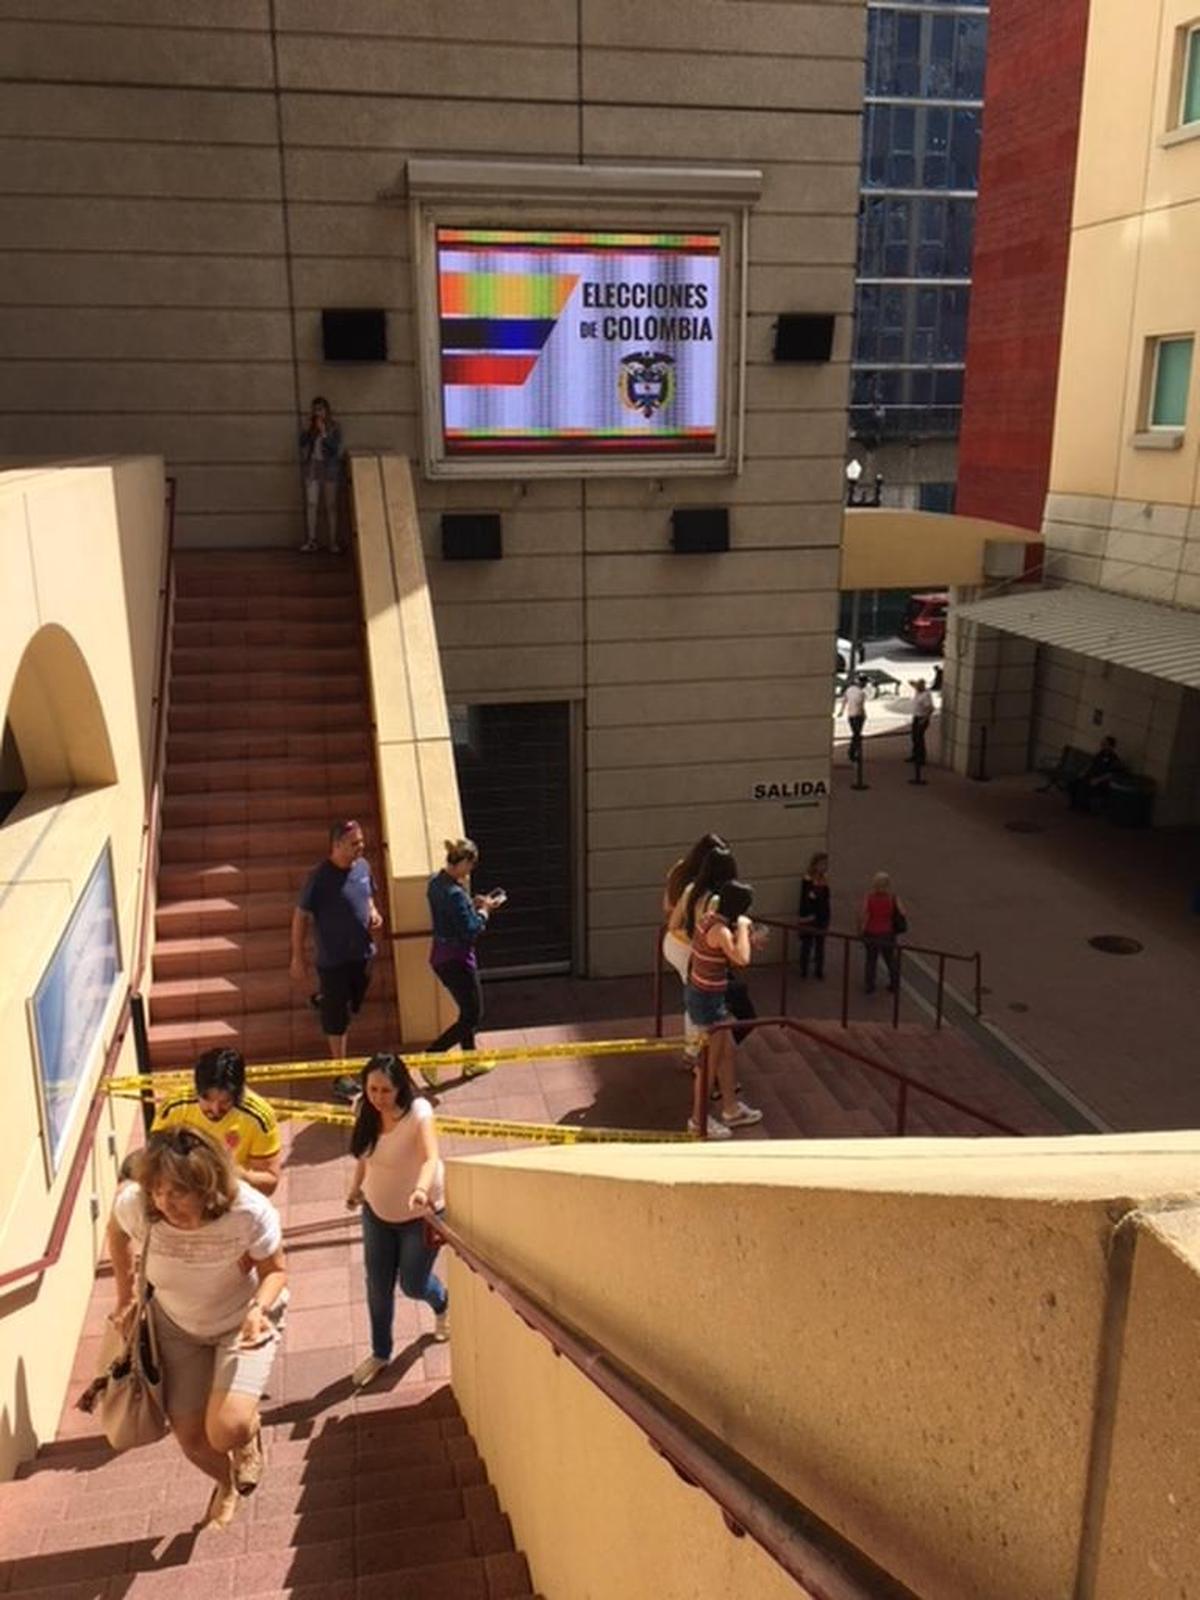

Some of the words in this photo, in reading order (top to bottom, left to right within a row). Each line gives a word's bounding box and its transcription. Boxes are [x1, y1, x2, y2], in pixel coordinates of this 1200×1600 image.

[582, 282, 708, 309] ELECCIONES
[579, 321, 598, 339] DE
[603, 316, 713, 342] COLOMBIA
[754, 781, 827, 799] SALIDA
